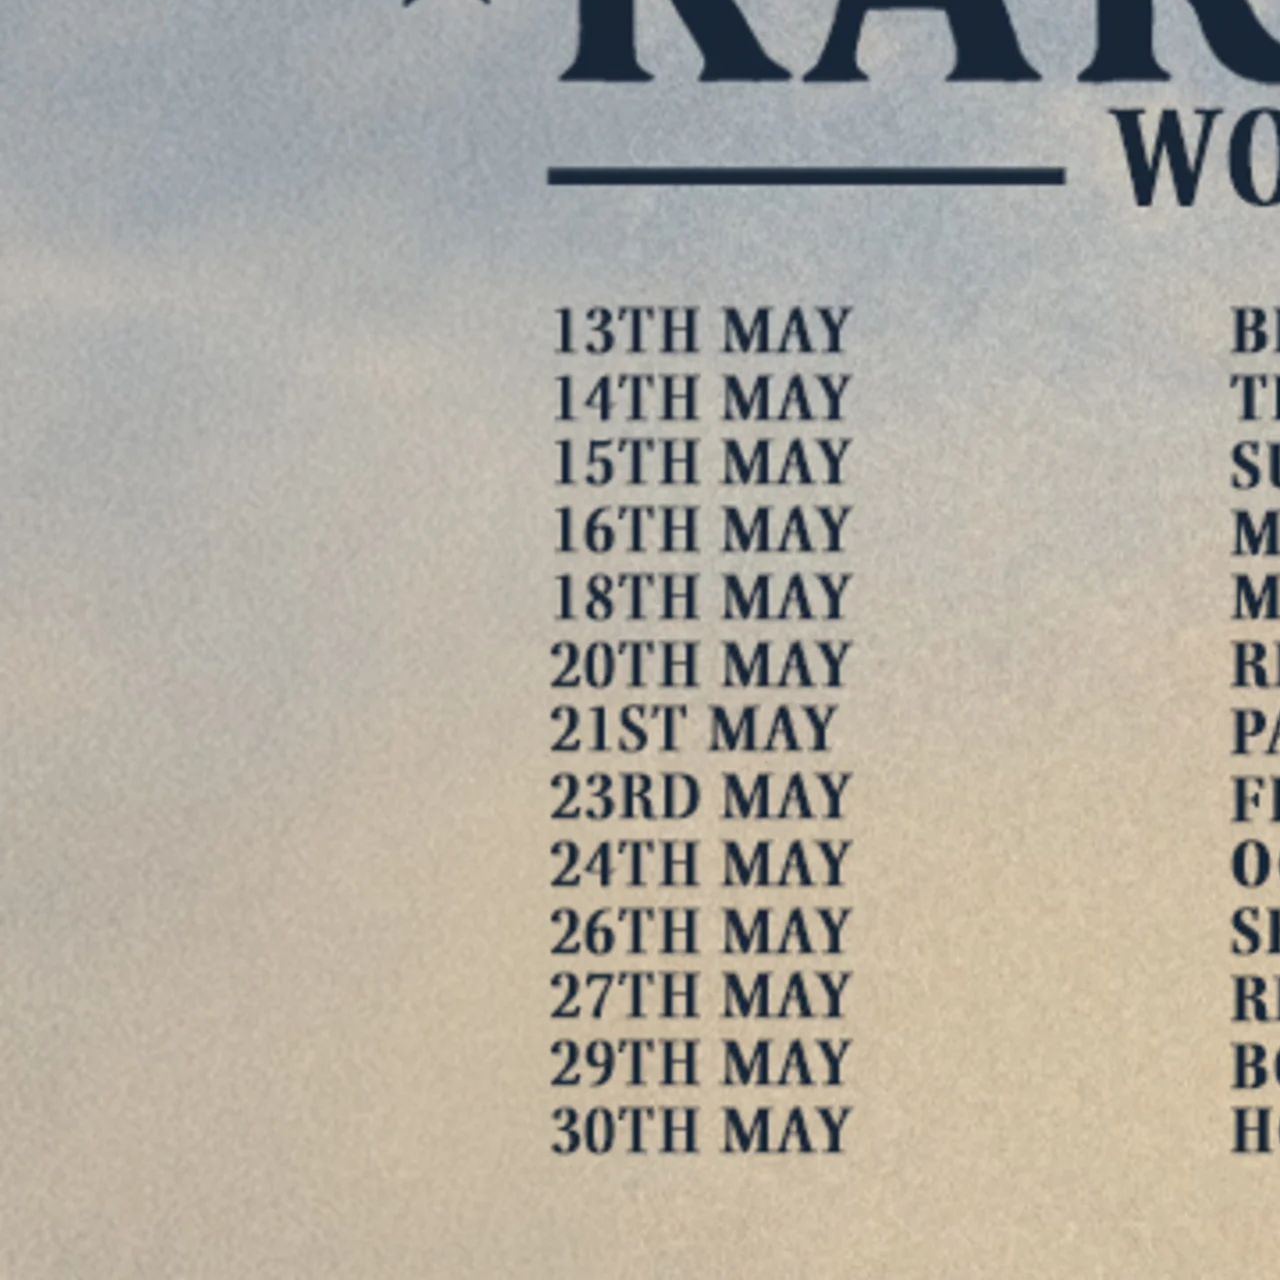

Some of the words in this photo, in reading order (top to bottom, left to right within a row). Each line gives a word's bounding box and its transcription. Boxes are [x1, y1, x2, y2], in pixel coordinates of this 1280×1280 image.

[559, 307, 697, 353] 13TH
[724, 307, 850, 353] MAY
[559, 375, 697, 421] 14TH
[724, 374, 849, 421] MAY
[559, 439, 696, 485] 15TH
[724, 439, 849, 485] MAY
[559, 507, 697, 553] 16TH
[724, 506, 849, 552] MAY
[560, 574, 697, 620] 18TH
[724, 573, 849, 620] MAY
[550, 642, 697, 688] 20TH
[724, 641, 849, 687] MAY
[551, 705, 687, 751] 21ST
[710, 705, 835, 751] MAY
[551, 773, 700, 819] 23RD
[724, 773, 849, 819] MAY
[551, 841, 697, 887] 24TH
[724, 840, 849, 886] MAY
[551, 908, 696, 954] 26TH
[724, 907, 849, 954] MAY
[551, 972, 697, 1018] 27TH
[724, 972, 849, 1018] MAY
[551, 1040, 696, 1086] 29TH
[724, 1039, 849, 1086] MAY
[552, 1108, 696, 1154] 30TH
[724, 1107, 849, 1153] MAY
